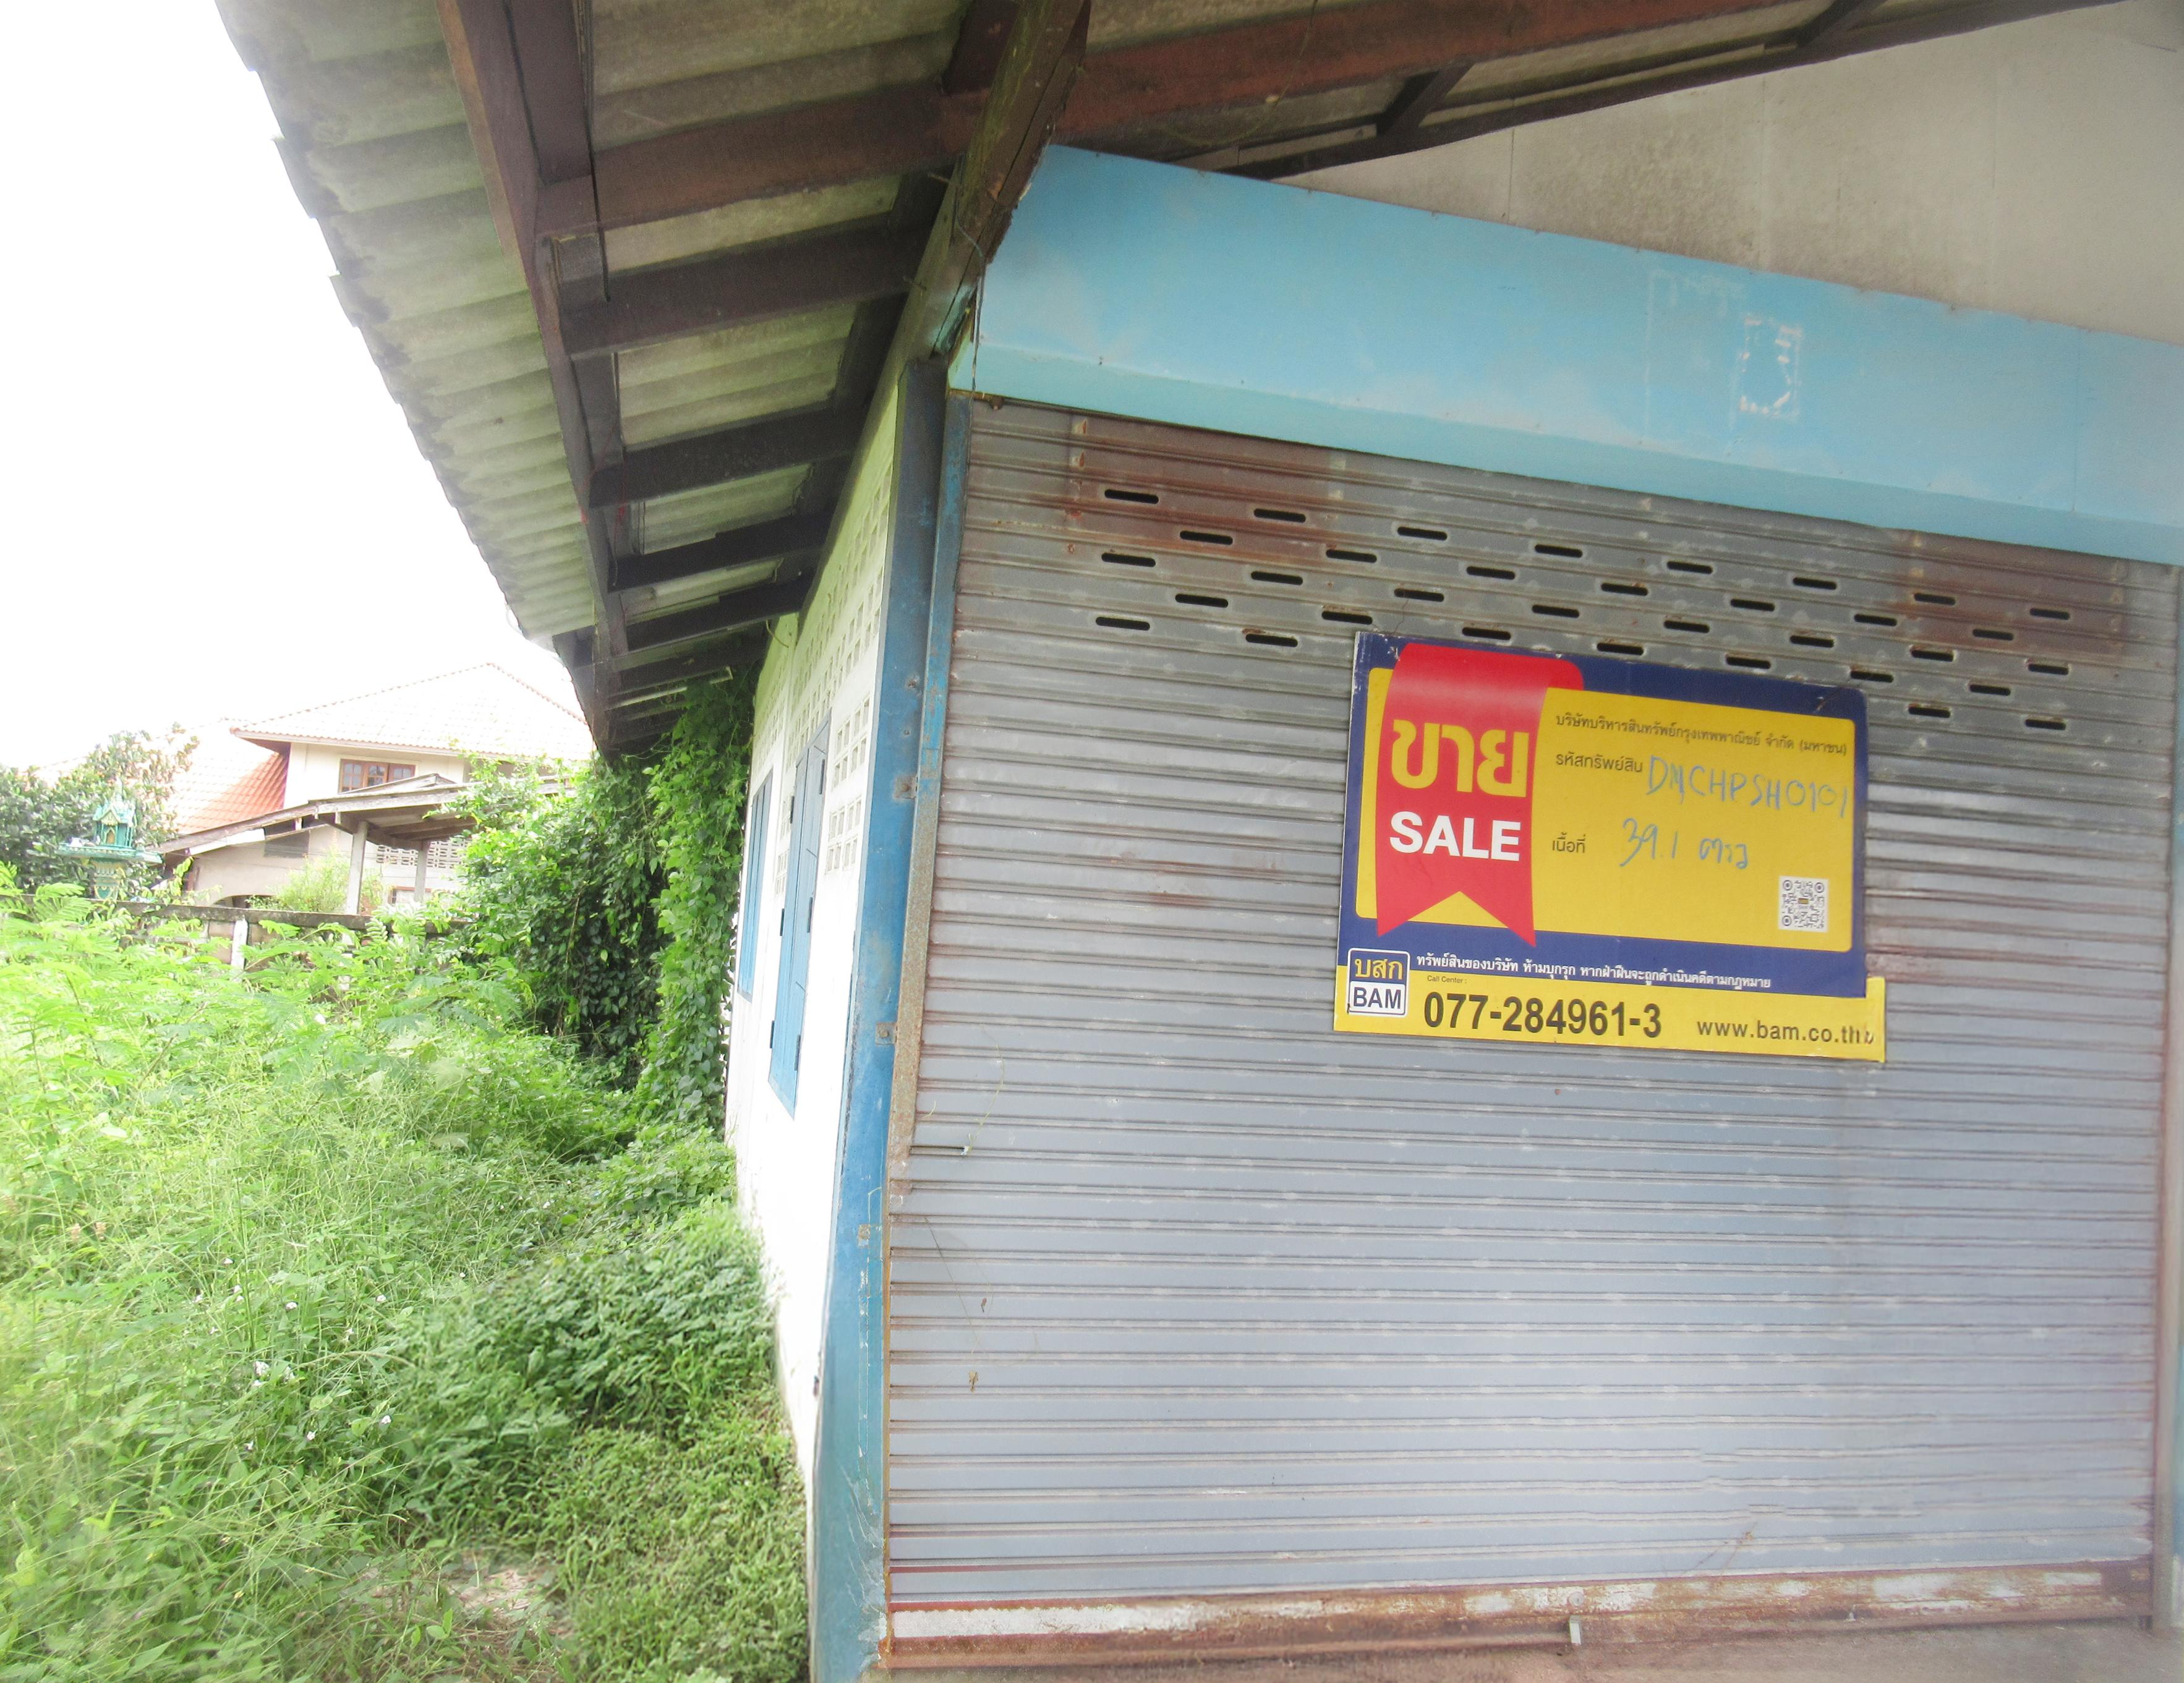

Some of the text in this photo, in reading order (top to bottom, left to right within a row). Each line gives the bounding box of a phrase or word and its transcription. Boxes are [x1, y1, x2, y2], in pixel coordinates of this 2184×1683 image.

[1766, 736, 1795, 750] จำกัด
[1799, 739, 1848, 756] (มหาชน)
[1391, 718, 1530, 798] ขาย
[1556, 752, 1643, 774] รหัสทรัพย์สิน
[1389, 811, 1521, 862] SALE
[1551, 832, 1586, 854] เนื้อที่
[1354, 957, 1403, 980] บสก
[1417, 952, 1518, 973] ทรัพย์สินของบริษัท
[1523, 958, 1576, 981] ห้ามบุกรุก
[1427, 974, 1440, 982] Call
[1441, 976, 1464, 984] Center
[1353, 986, 1401, 1010] BAM
[1423, 991, 1662, 1038] 077-284961-3
